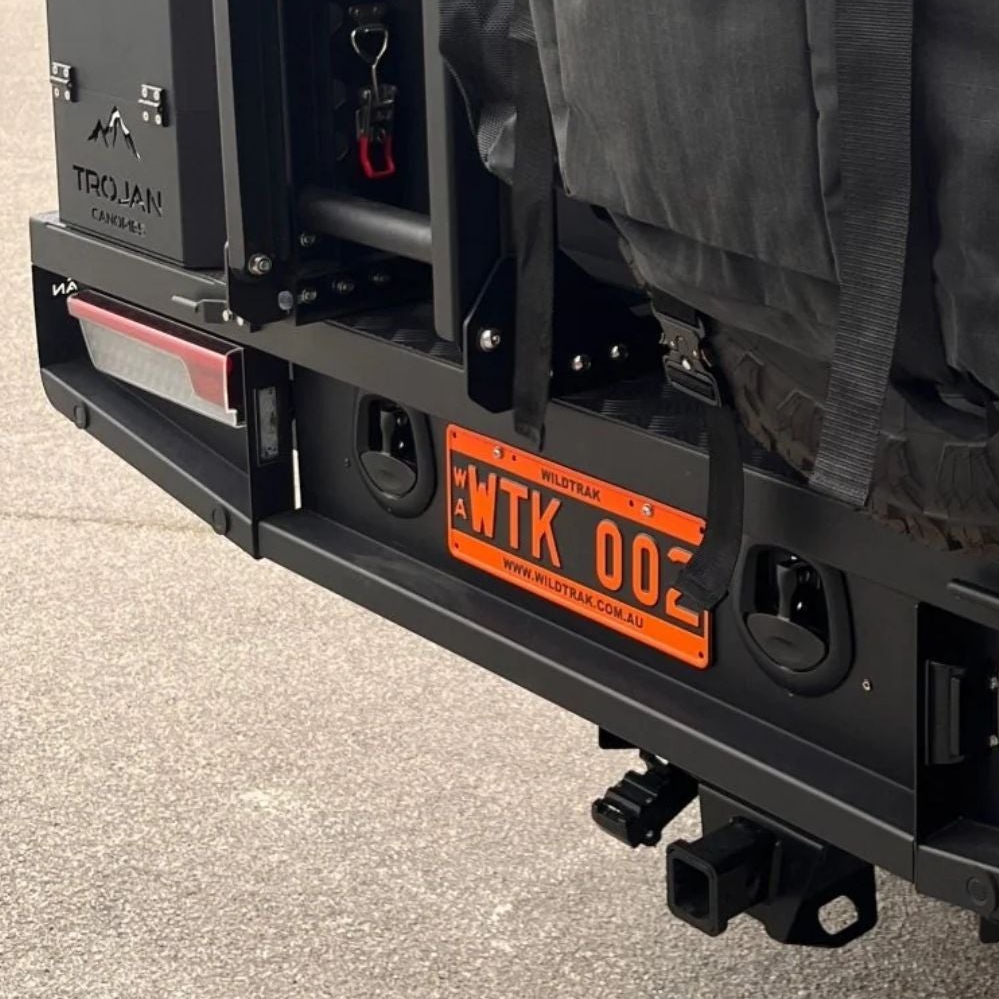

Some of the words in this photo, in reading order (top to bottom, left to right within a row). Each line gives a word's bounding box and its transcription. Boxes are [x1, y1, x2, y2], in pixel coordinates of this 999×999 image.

[72, 164, 162, 217] TROJAN
[541, 468, 601, 501] WILDTRAK
[467, 464, 561, 569] WTK
[595, 518, 700, 628] 002
[502, 557, 644, 630] WWW.WILDTRAK.COM.AU
